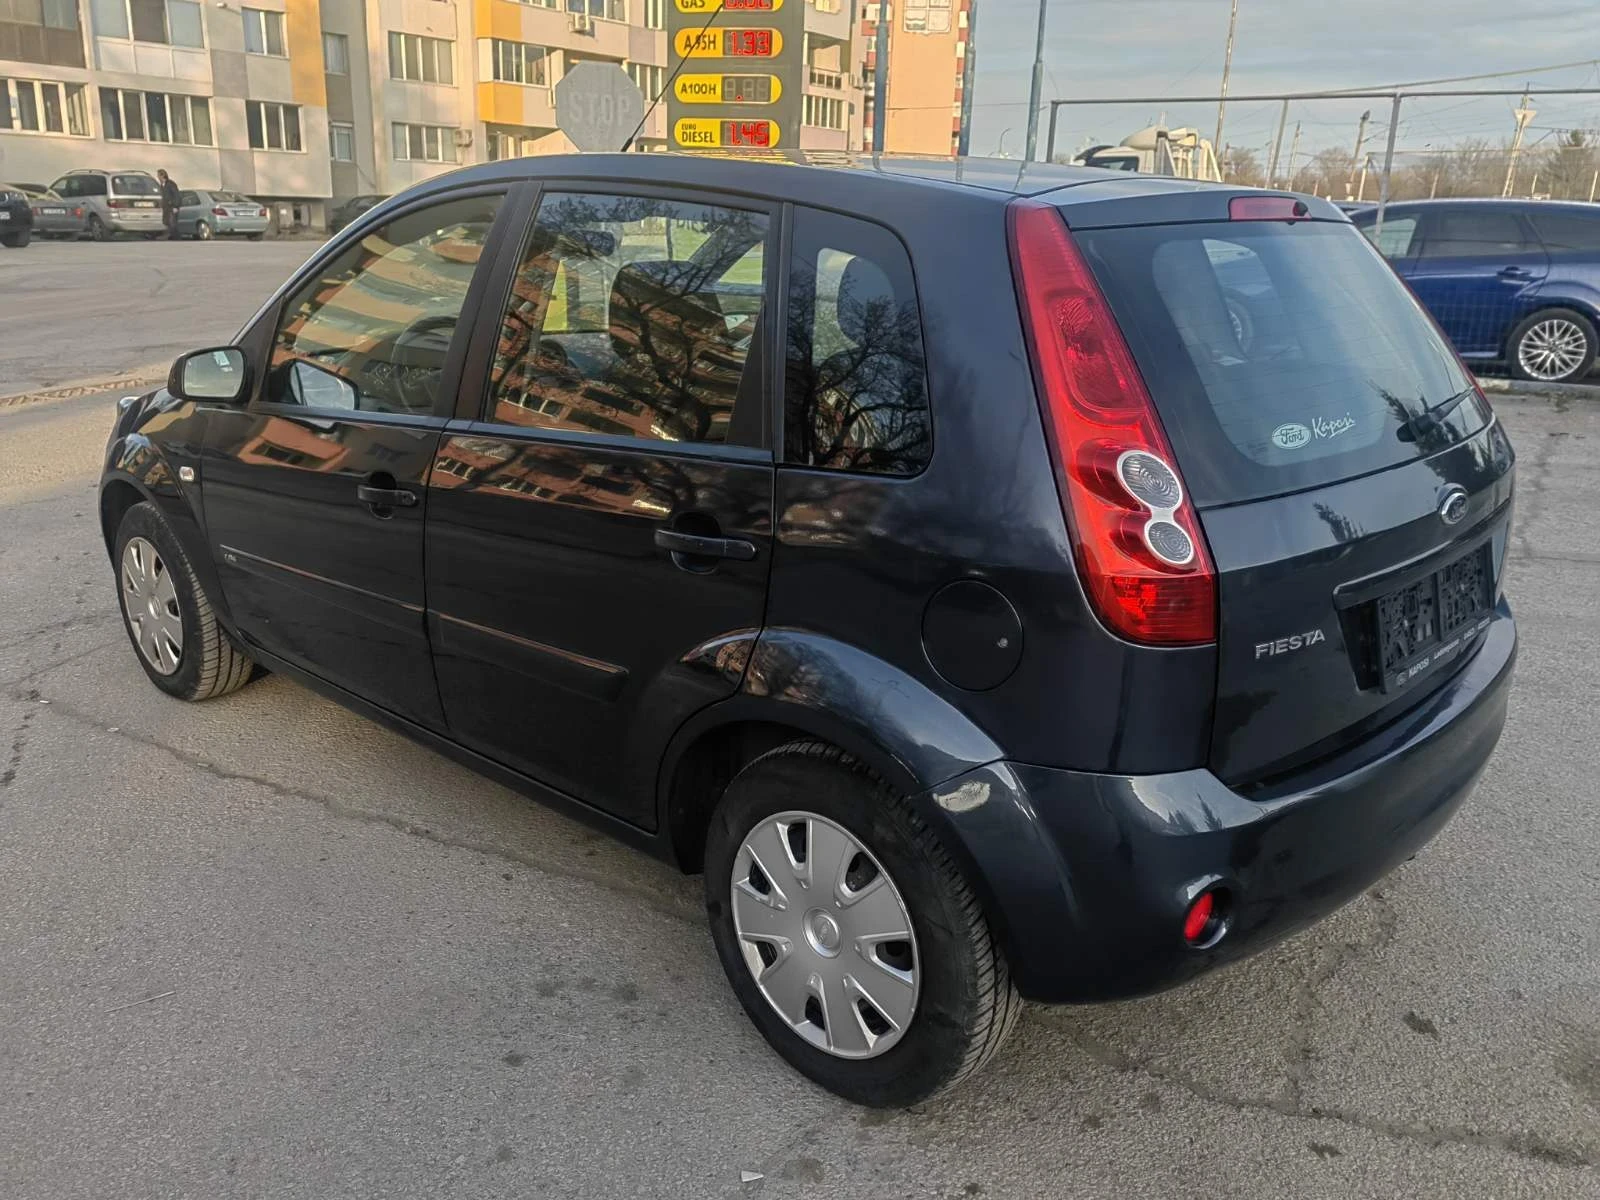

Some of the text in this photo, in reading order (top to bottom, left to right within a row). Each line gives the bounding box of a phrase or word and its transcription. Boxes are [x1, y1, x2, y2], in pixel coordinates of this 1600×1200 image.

[731, 31, 771, 56] 1.33
[568, 91, 630, 127] STOP
[681, 121, 770, 147] DIESEL 1.45
[1255, 629, 1326, 660] FIESTA
